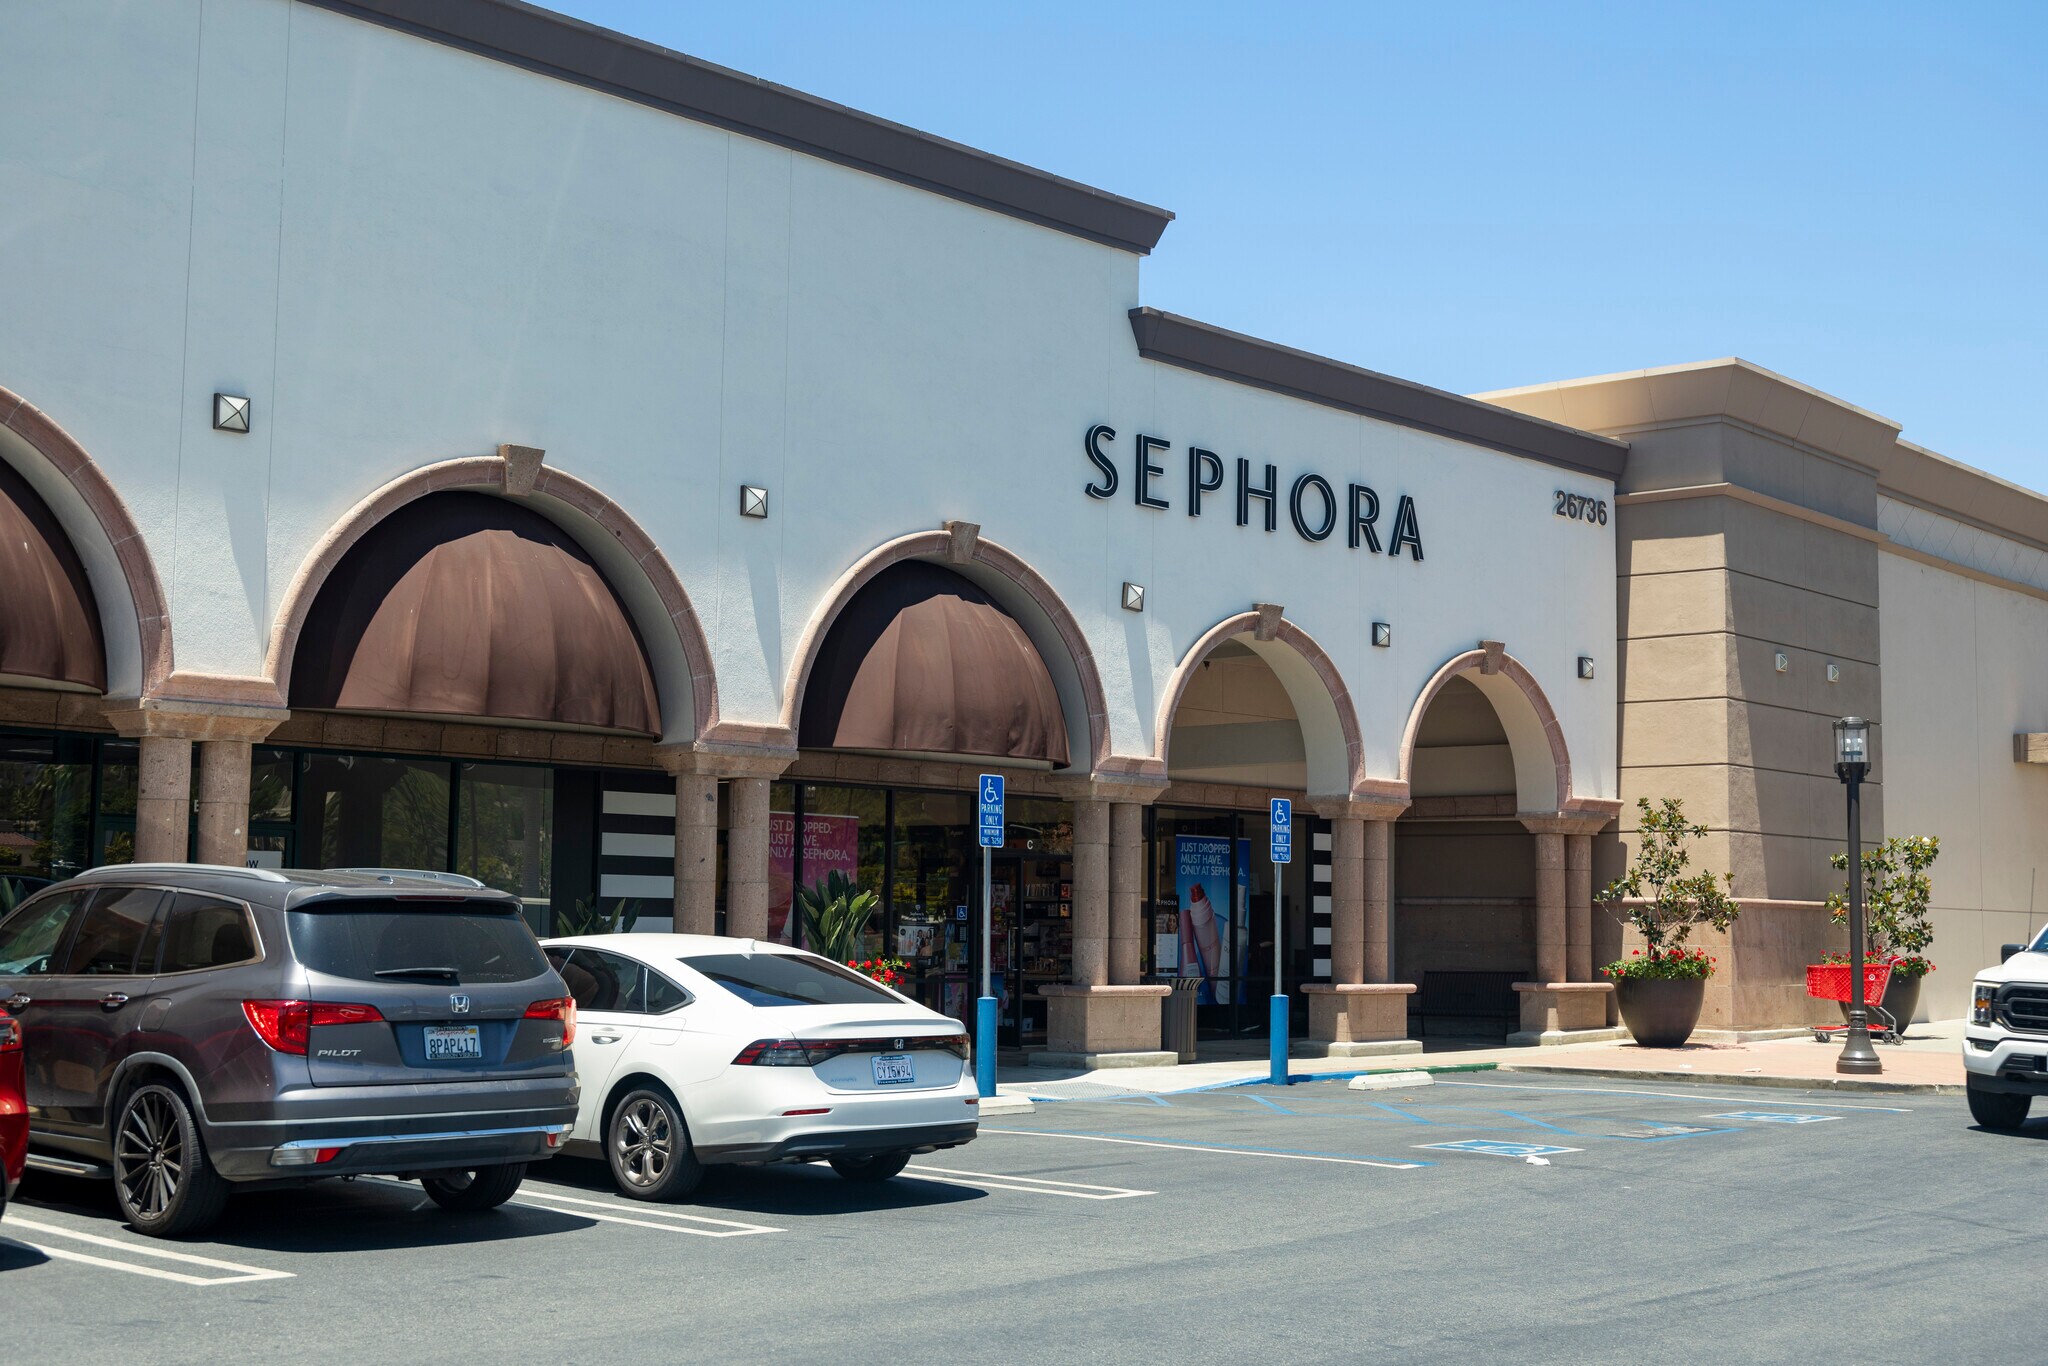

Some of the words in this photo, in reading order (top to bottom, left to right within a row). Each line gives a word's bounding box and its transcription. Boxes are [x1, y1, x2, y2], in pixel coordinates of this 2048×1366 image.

[1085, 423, 1425, 562] SEPHORA
[1553, 489, 1608, 526] 26736
[981, 803, 1003, 815] PARKING
[985, 815, 999, 825] ONLY
[1272, 824, 1290, 834] PARKING
[770, 833, 789, 845] UST
[1026, 839, 1034, 850] C
[1275, 834, 1287, 843] ONLY
[769, 846, 789, 858] NLY
[802, 847, 851, 861] SEPHORA.
[1180, 842, 1197, 853] JUST
[1180, 853, 1201, 864] MUST
[1202, 854, 1223, 865] HAVE.
[1180, 865, 1201, 875] ONLY
[1201, 865, 1210, 876] AT
[1210, 866, 1246, 877] SEPHA.
[429, 1037, 476, 1054] 8PAP417
[317, 1049, 362, 1057] PILOT
[876, 1065, 911, 1079] CY15W94
